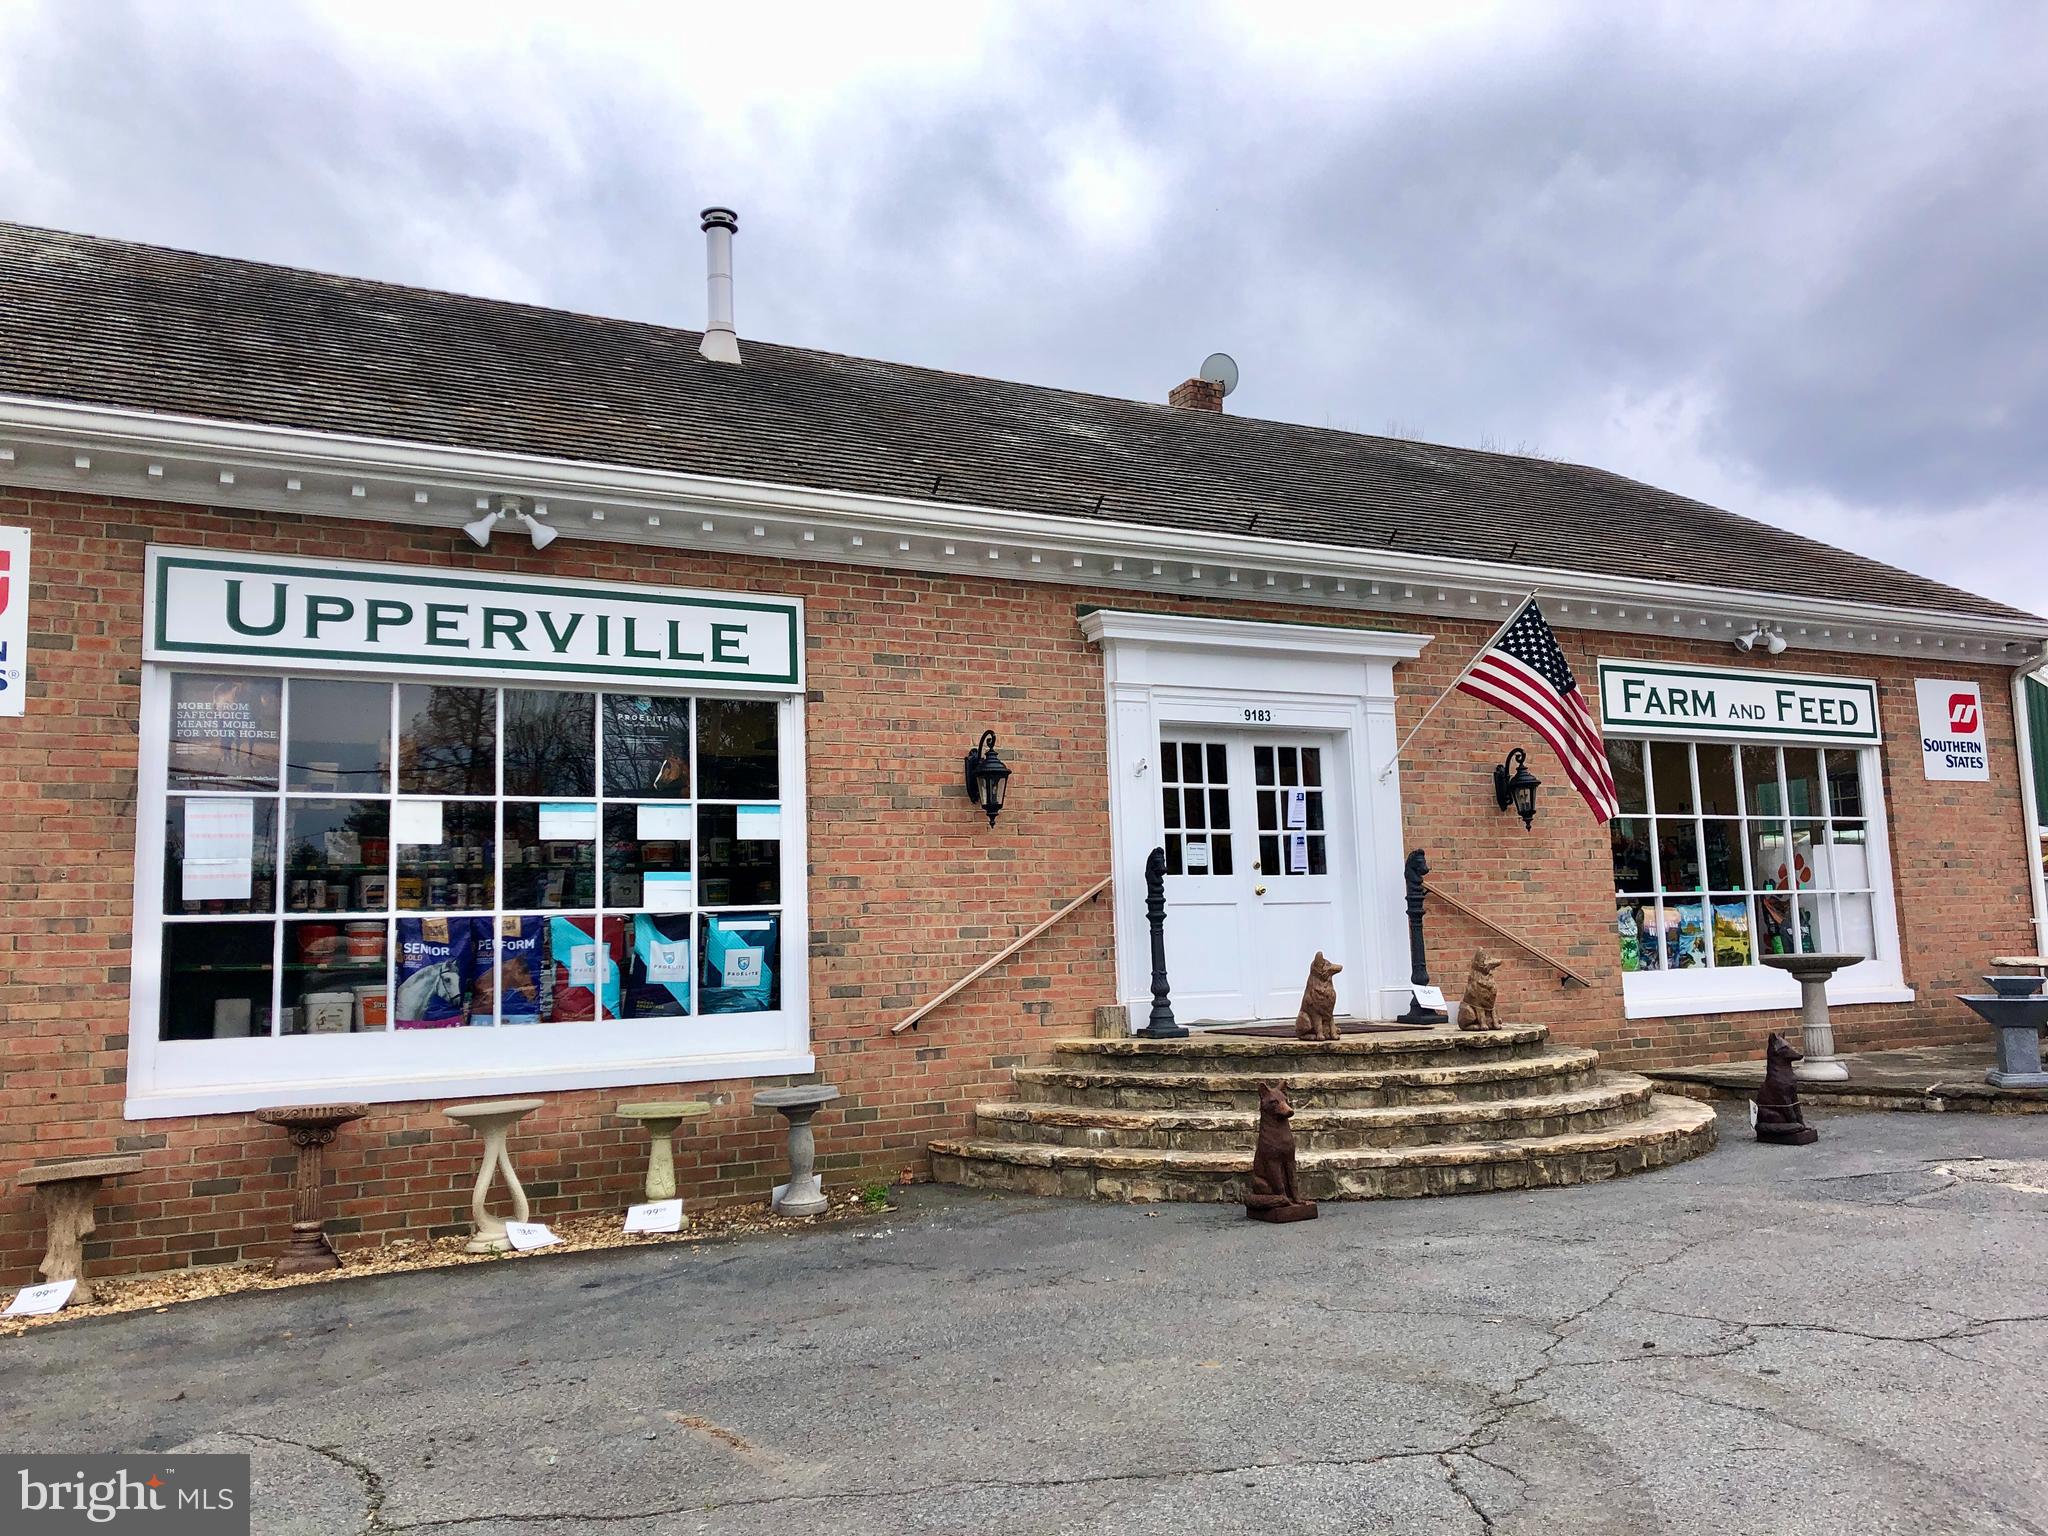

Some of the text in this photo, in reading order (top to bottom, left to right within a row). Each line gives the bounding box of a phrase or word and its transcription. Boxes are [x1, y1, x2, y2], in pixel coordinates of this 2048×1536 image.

[224, 578, 750, 665] UPPERVILLE
[176, 702, 249, 711] MORE FROM
[1622, 679, 1859, 726] FARM AND FEED
[176, 711, 250, 720] SAFECHOICE
[617, 713, 669, 722] PROELITE
[1244, 709, 1271, 722] 9183
[177, 720, 256, 729] MEANS MORE
[177, 729, 279, 740] FOR YOUR HORSE.
[1923, 738, 1982, 753] SOUTHERN
[1945, 754, 1984, 769] STATES
[403, 942, 450, 956] SENIOR
[478, 939, 535, 950] PEFORM
